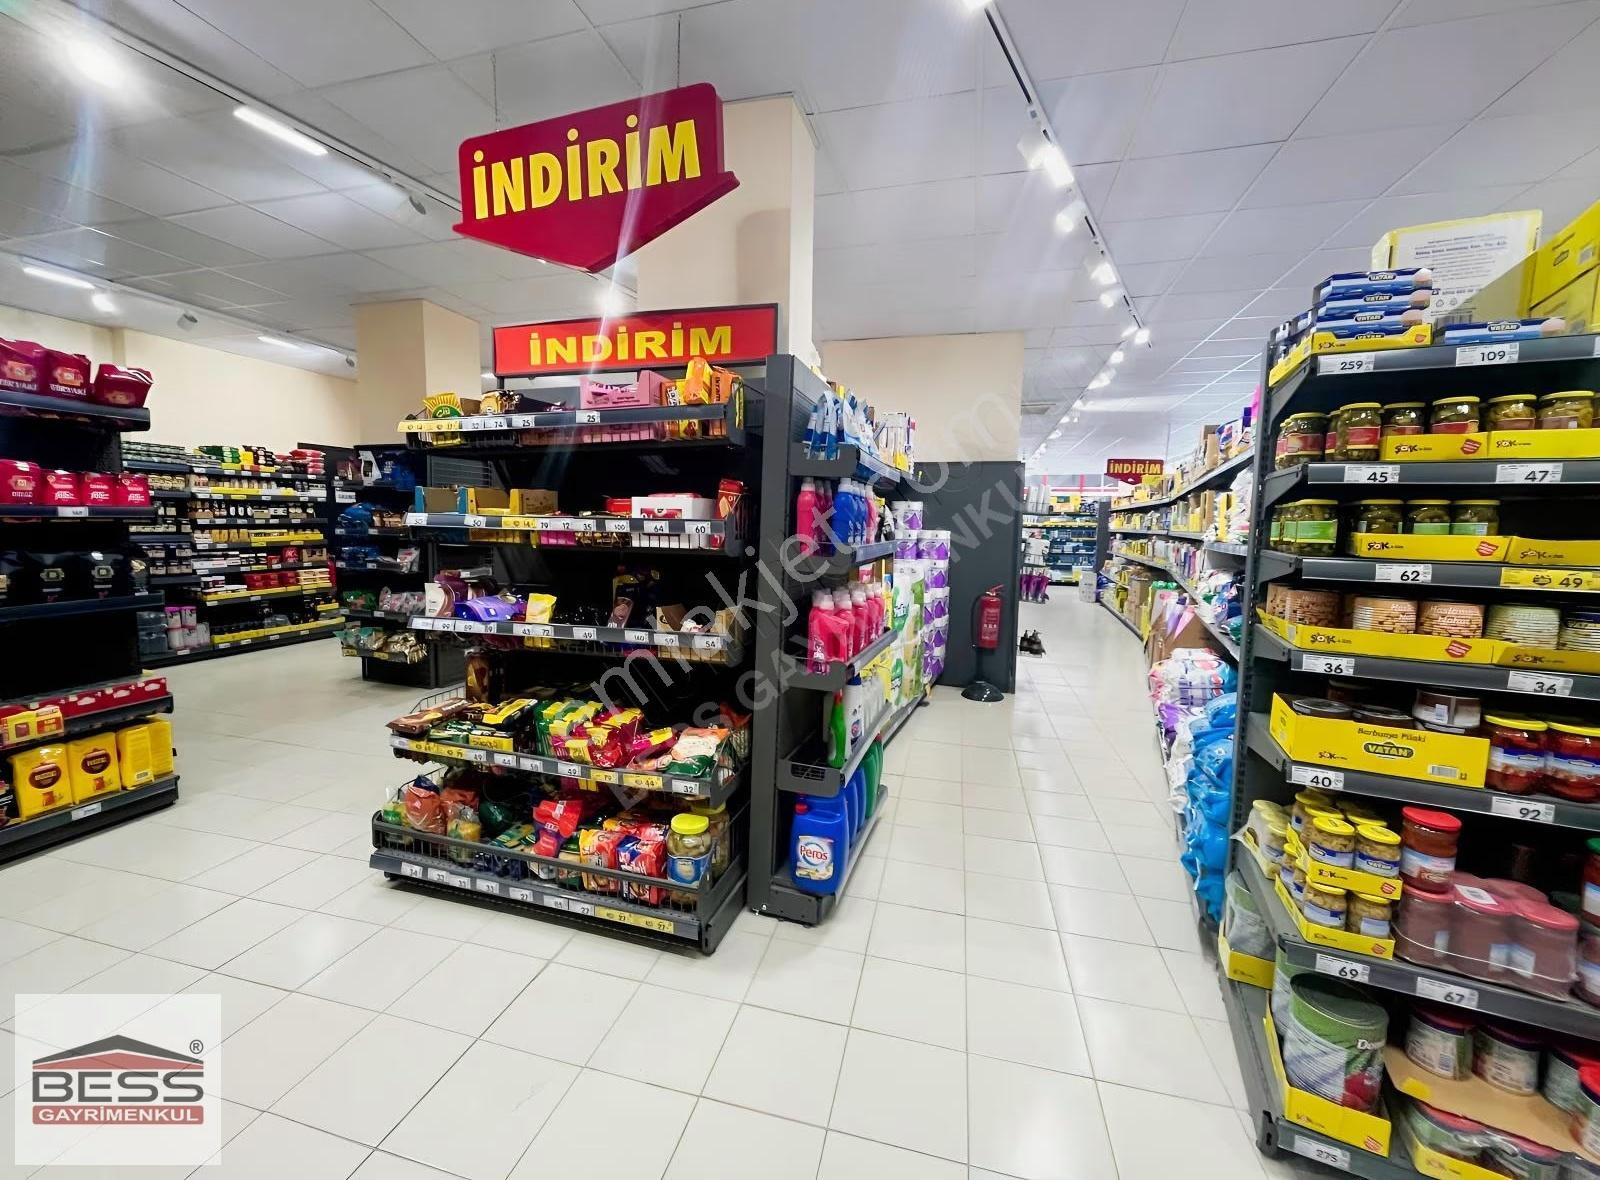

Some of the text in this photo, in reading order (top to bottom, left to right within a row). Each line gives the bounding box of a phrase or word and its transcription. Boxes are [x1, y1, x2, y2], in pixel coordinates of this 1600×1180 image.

[472, 113, 702, 221] İNDİRİM
[528, 320, 733, 366] İNDİRİM
[1480, 351, 1506, 362] 109
[1340, 361, 1363, 371] 259
[587, 414, 596, 423] 25
[1110, 459, 1161, 475] İNDİRİM
[1367, 471, 1388, 482] 45
[1524, 470, 1549, 482] 47
[695, 525, 706, 534] 60
[1400, 570, 1420, 582] 62
[1559, 577, 1583, 588] 49
[705, 640, 716, 648] 54
[1324, 662, 1343, 674] 36
[1533, 681, 1557, 694] 36
[1358, 727, 1399, 739] Barbunya
[1368, 743, 1409, 757] VATAN
[567, 768, 577, 776] 49
[1310, 775, 1332, 787] 40
[683, 785, 695, 794] 32
[1519, 807, 1541, 821] 92
[799, 844, 829, 863] Peros
[1339, 966, 1359, 980] 69
[1443, 991, 1465, 1005] 67
